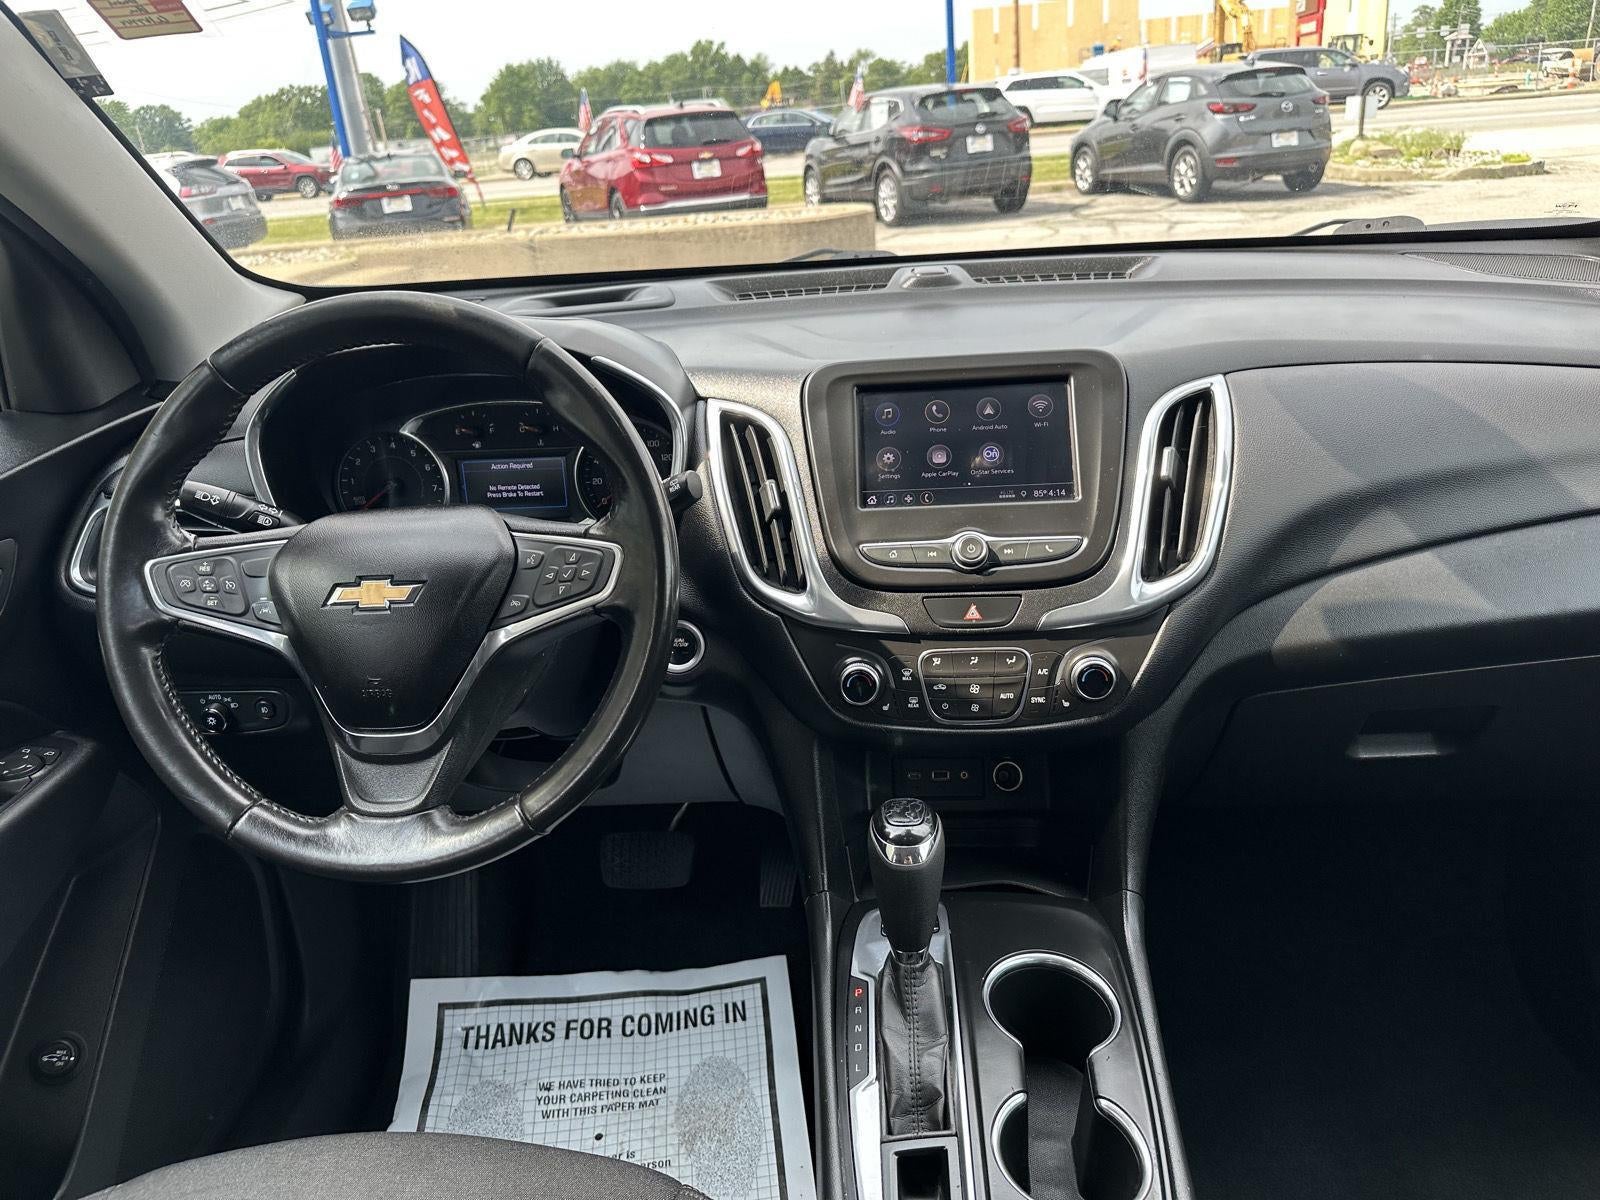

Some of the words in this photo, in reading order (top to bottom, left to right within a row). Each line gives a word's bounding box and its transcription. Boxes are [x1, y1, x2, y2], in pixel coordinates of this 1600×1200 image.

[432, 484, 438, 492] 7
[1048, 489, 1066, 497] 4:14
[1037, 668, 1049, 676] A/C
[1030, 696, 1046, 704] SYNC
[855, 988, 863, 997] P
[855, 1006, 862, 1014] R
[461, 1020, 556, 1050] THANKS
[564, 1017, 612, 1040] FOR
[621, 1004, 715, 1038] COMING
[724, 1000, 748, 1024] IN
[855, 1024, 862, 1033] N
[855, 1043, 862, 1052] D
[855, 1063, 862, 1072] L
[538, 1081, 556, 1092] WE
[558, 1079, 586, 1090] HAVE
[589, 1078, 620, 1087] TRIED
[623, 1076, 637, 1086] TO
[640, 1073, 666, 1084] KEEP
[536, 1093, 566, 1106] YOUR
[570, 1089, 630, 1103] CARPETING
[633, 1086, 667, 1098] CLEAN
[541, 1108, 570, 1119] WITH
[574, 1105, 598, 1116] THIS
[601, 1101, 635, 1113] PAPER
[638, 1098, 661, 1109] MAT
[626, 1150, 636, 1159] is
[641, 1159, 672, 1169] erson
